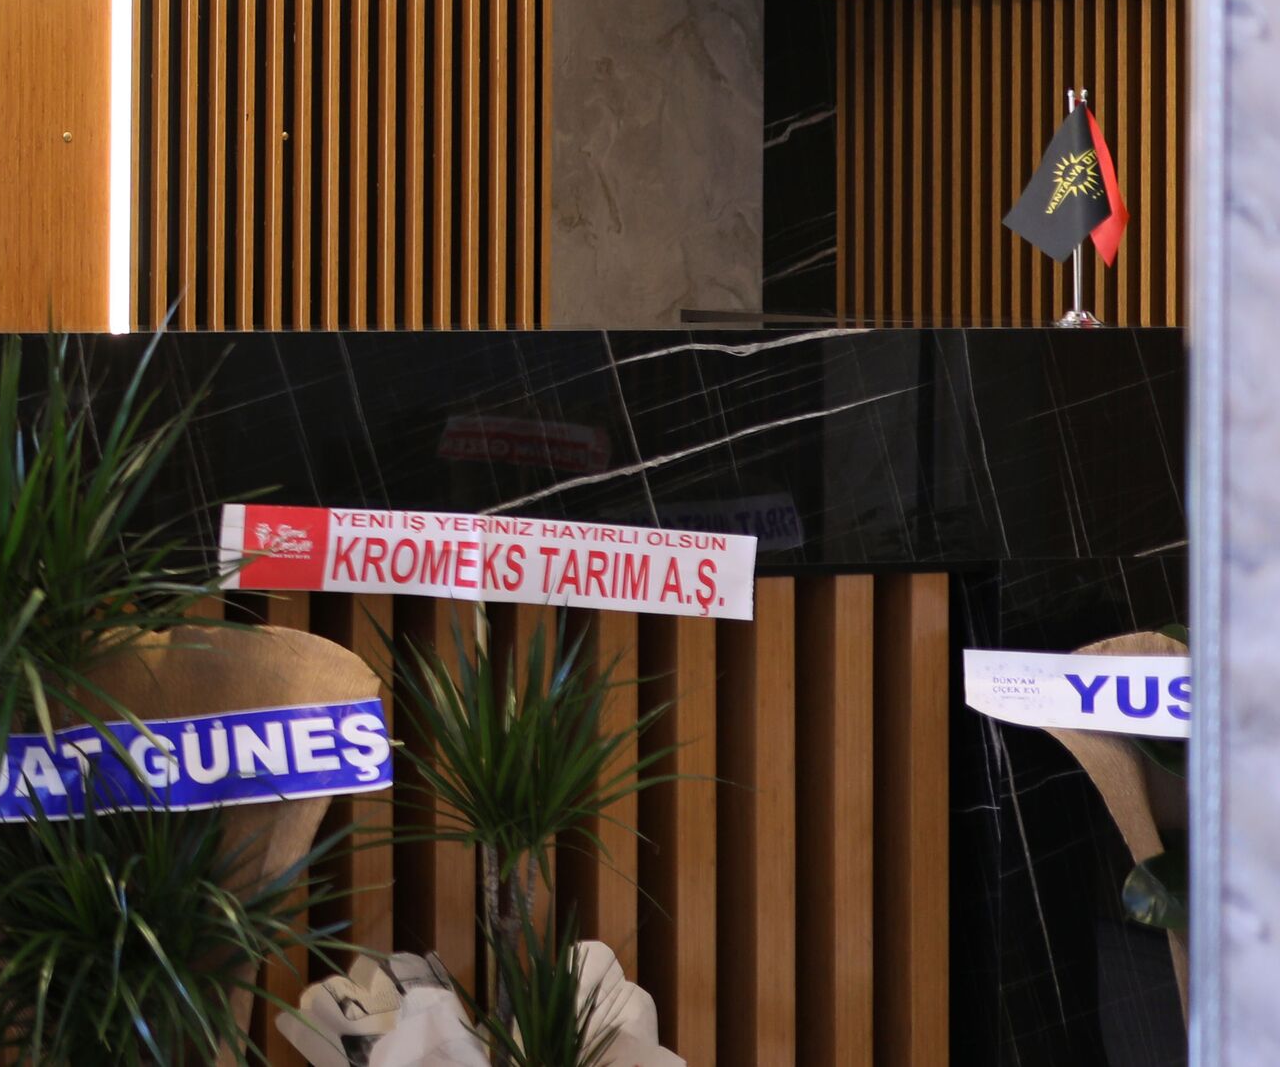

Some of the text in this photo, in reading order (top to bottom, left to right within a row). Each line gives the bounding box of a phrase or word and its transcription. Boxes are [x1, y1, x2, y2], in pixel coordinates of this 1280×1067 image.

[332, 511, 727, 551] YENİ İŞ YERİNİZ HAYIRLI OLSUN
[331, 536, 525, 592] KROMEKS
[539, 546, 650, 602] TARIM
[660, 557, 726, 616] A.Ş.
[140, 712, 391, 788] GÜNEŞ
